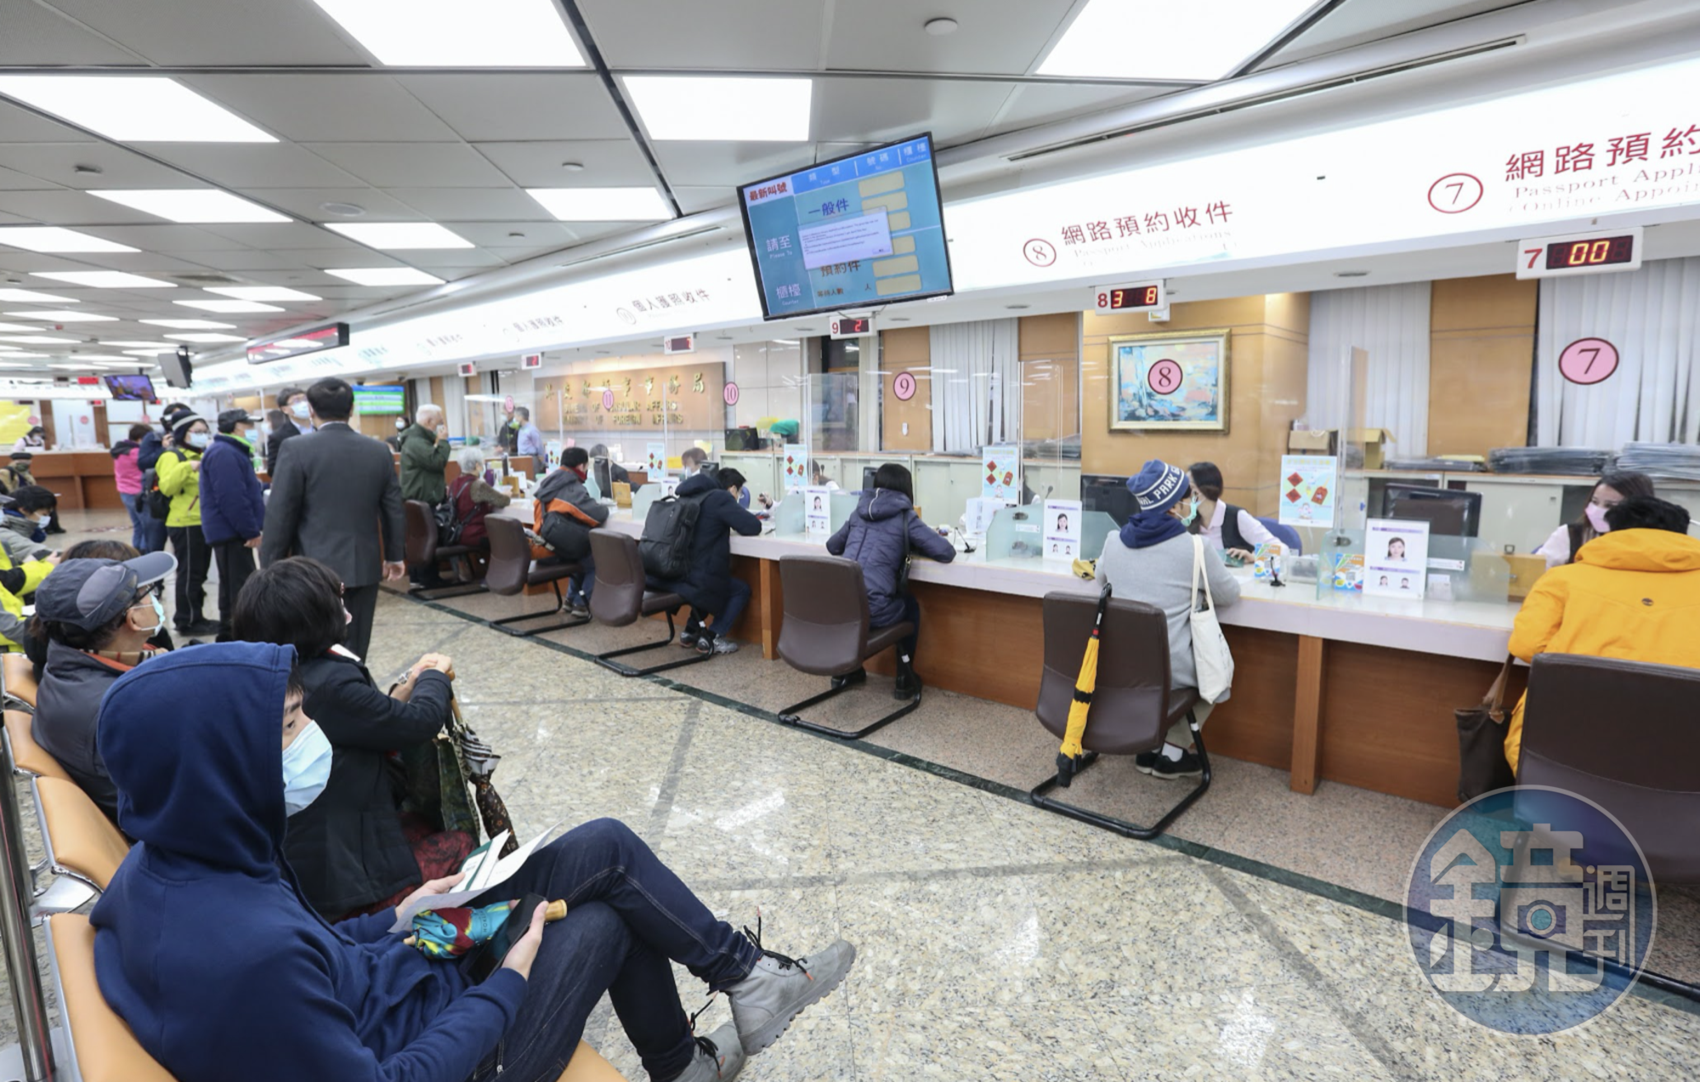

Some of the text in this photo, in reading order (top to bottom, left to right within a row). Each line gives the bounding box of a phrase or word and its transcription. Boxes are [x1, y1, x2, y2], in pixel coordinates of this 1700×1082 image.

[1504, 124, 1700, 182] 網路預約
[1515, 162, 1700, 199] Passport Appl
[749, 181, 788, 202] 最新叫號
[1445, 182, 1465, 205] 7
[808, 198, 850, 216] 一般件
[1061, 200, 1233, 246] 網路預約收件
[766, 234, 792, 252] 請至
[1032, 244, 1048, 262] 8
[1567, 240, 1610, 265] 00
[820, 259, 861, 277] 預約件
[1523, 248, 1543, 269] 7
[1097, 292, 1108, 308] 8
[831, 322, 839, 334] 9
[1577, 347, 1602, 375] 7
[900, 378, 910, 395] 9
[1158, 366, 1172, 387] 8
[725, 388, 737, 400] 10
[1153, 474, 1178, 500] PARK
